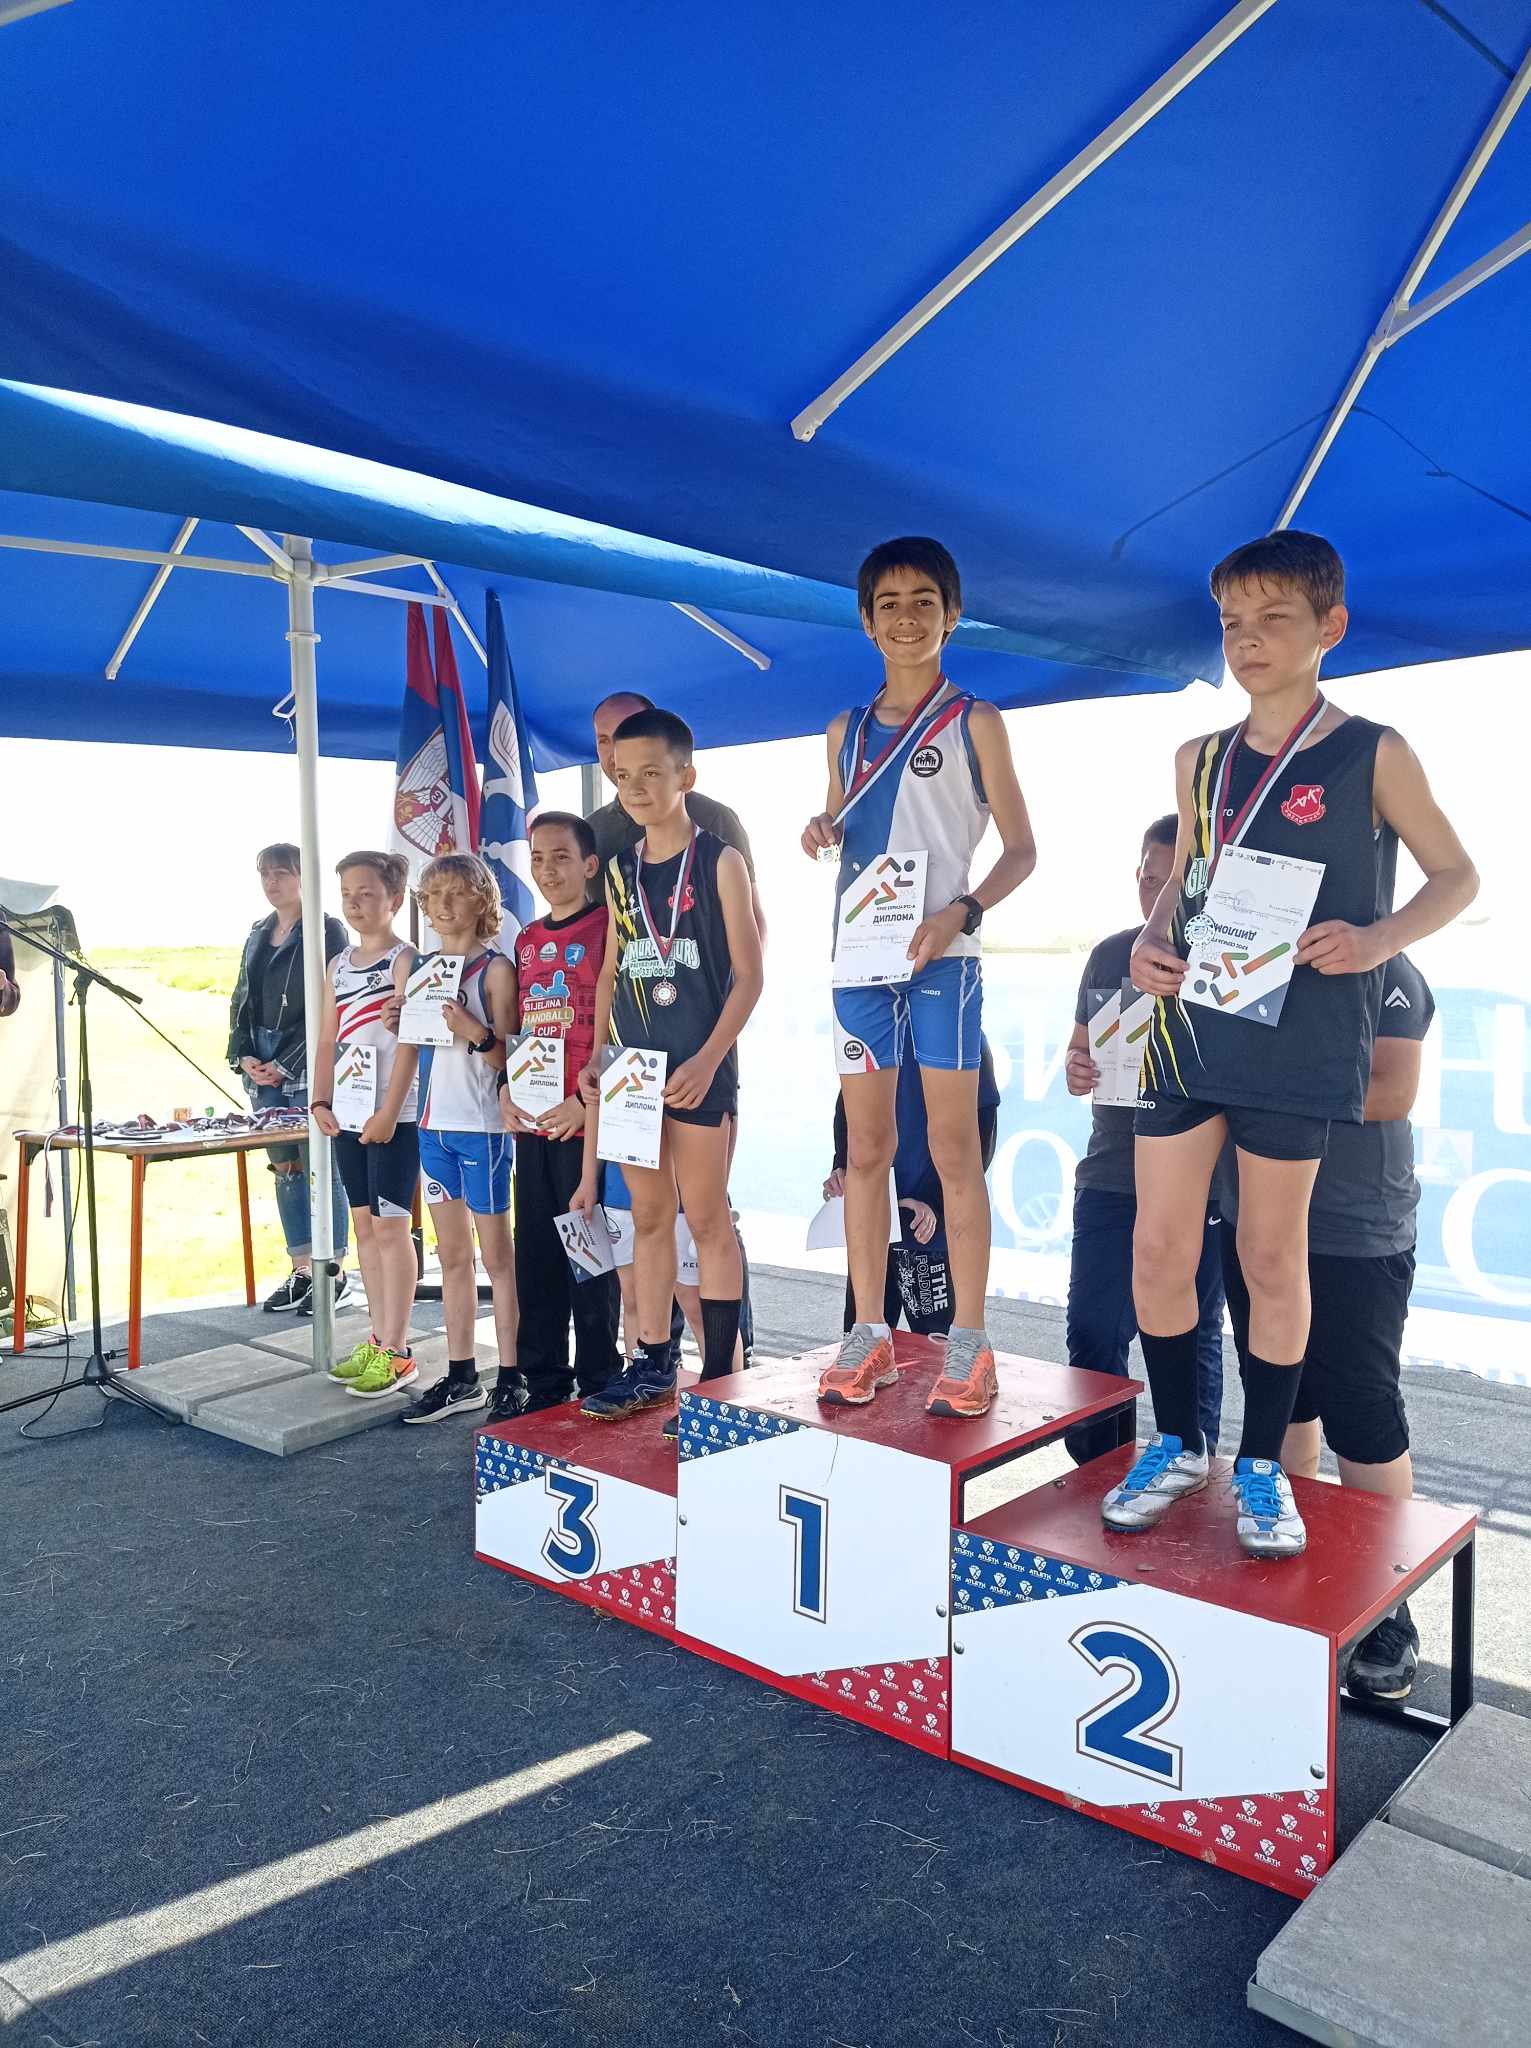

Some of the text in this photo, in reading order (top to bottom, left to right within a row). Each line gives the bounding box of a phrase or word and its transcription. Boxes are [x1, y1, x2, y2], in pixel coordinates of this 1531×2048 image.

[873, 913, 914, 924] ДИПЛОМА
[1213, 923, 1257, 942] ДИПЛОМ
[524, 999, 561, 1011] BIJELJINA
[523, 1012, 572, 1026] HANDBALL
[537, 1026, 557, 1037] CUP
[625, 1101, 657, 1112] ДИПЛОМА
[915, 1255, 933, 1315] FOLDING
[931, 1272, 949, 1312] THE
[541, 1463, 602, 1582] 3
[779, 1484, 829, 1625] 1
[1068, 1620, 1184, 1791] 2
